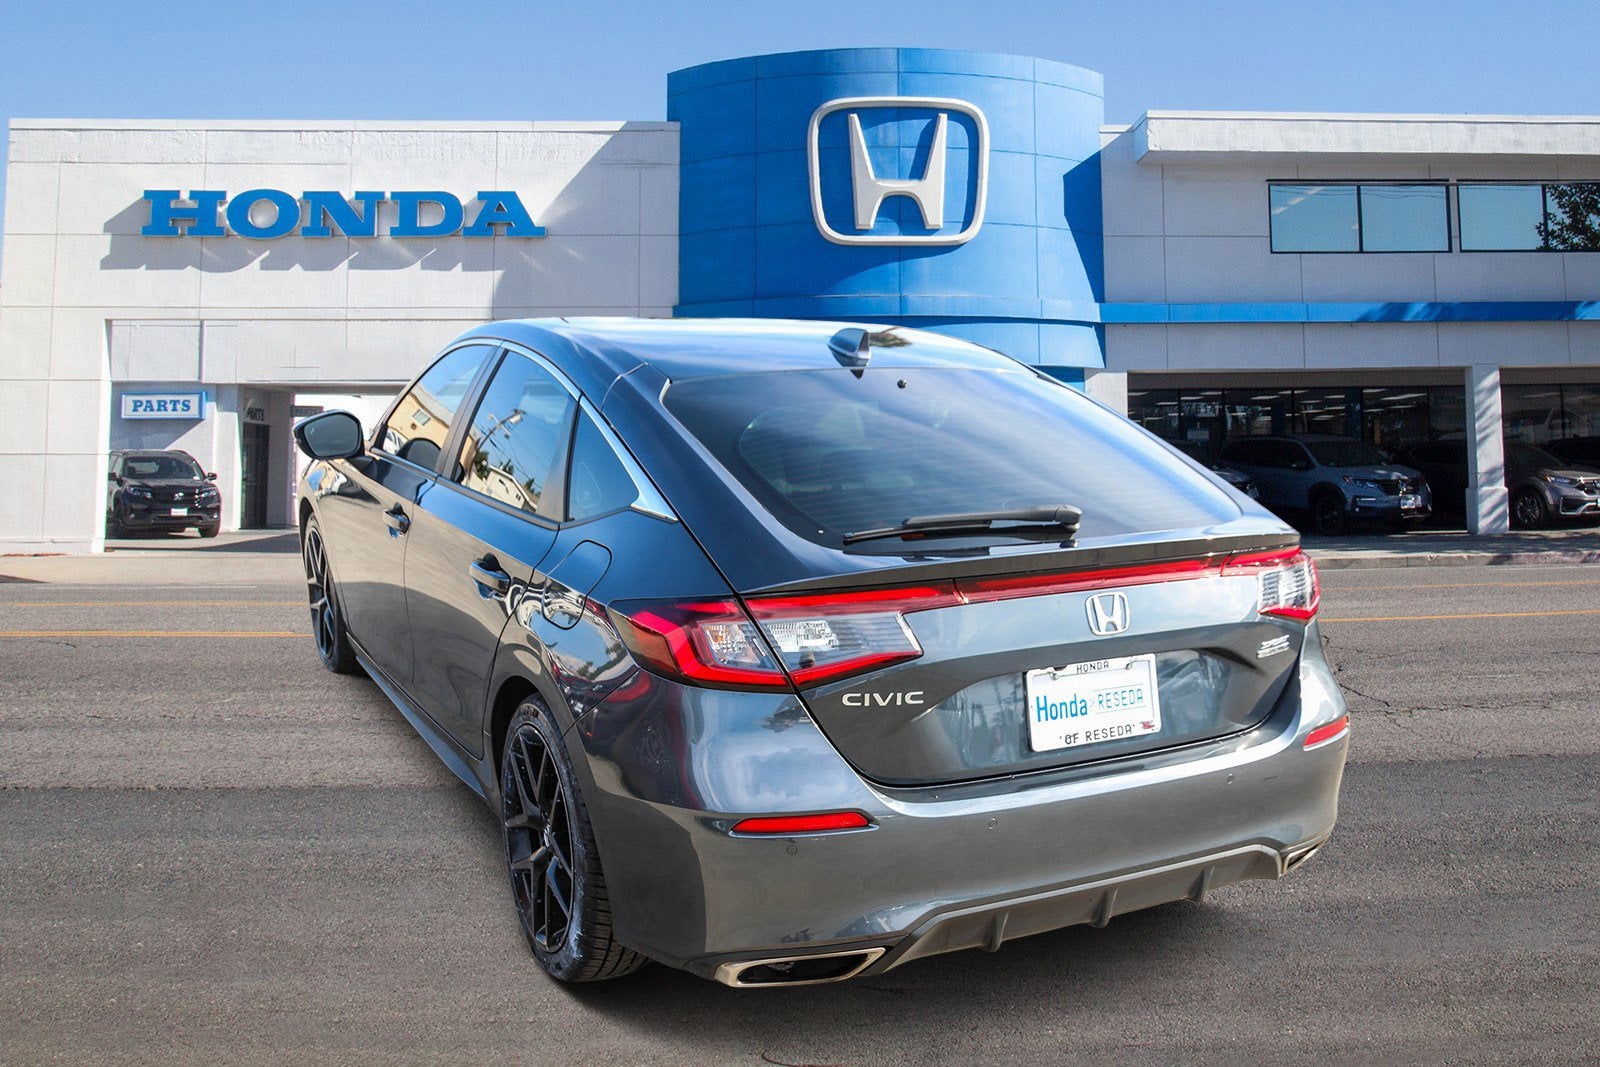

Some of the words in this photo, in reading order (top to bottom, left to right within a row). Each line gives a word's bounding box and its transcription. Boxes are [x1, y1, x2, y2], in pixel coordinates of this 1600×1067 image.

[141, 189, 547, 239] HONDA
[132, 400, 191, 412] PARTS
[1076, 661, 1110, 674] HONDA
[842, 691, 924, 707] CIVIC
[1036, 693, 1088, 723] Honda
[1098, 688, 1143, 710] RESEDA
[1065, 734, 1079, 745] OF
[1086, 724, 1132, 742] RESEDA
